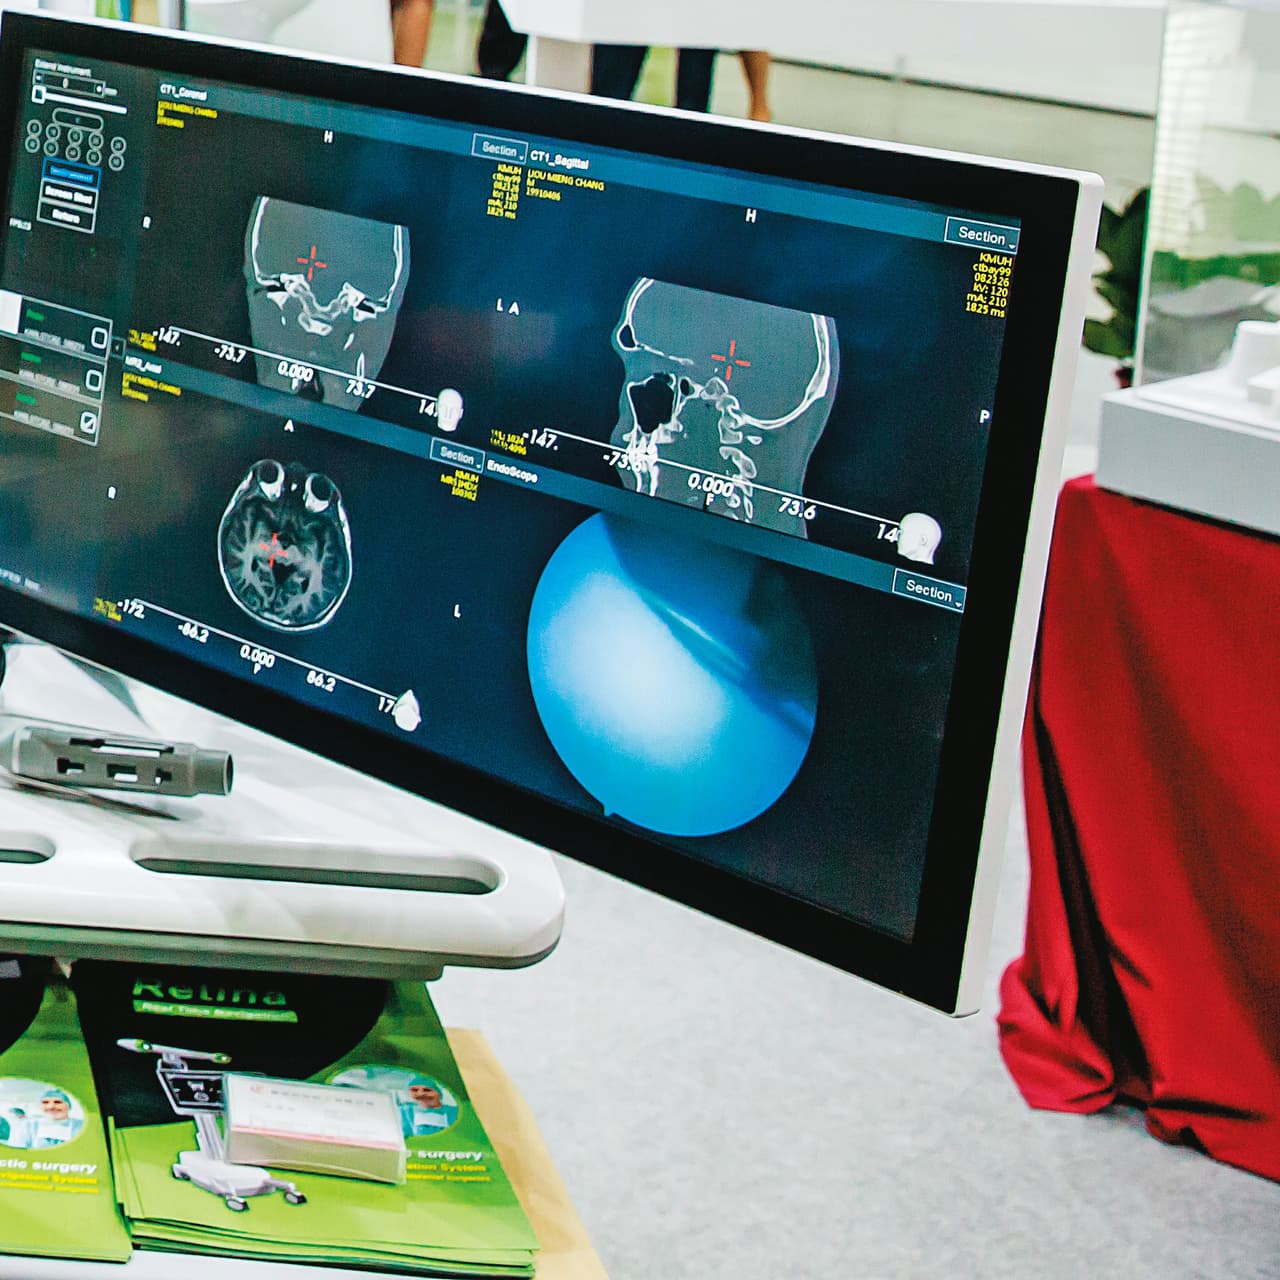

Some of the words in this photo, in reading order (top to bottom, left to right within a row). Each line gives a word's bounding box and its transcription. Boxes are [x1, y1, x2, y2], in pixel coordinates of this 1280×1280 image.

[323, 130, 334, 144] H
[482, 141, 517, 157] Section
[530, 150, 589, 170] CT1_Sagittal
[575, 178, 605, 191] CHANG
[745, 208, 757, 223] H
[958, 226, 1006, 245] Section
[980, 252, 1013, 267] KMUH
[972, 263, 1012, 278] ctbay99
[974, 272, 1010, 288] 082326
[991, 286, 1008, 298] 120
[496, 297, 504, 312] L
[508, 301, 520, 316] A
[988, 296, 1007, 308] 210
[965, 302, 989, 315] 1825
[990, 308, 1006, 319] ms
[278, 360, 314, 383] 0.000
[344, 379, 377, 400] 73.7
[418, 399, 438, 418] 14
[980, 410, 990, 424] P
[283, 419, 295, 433] A
[440, 446, 474, 465] Section
[487, 459, 538, 483] EndoScope
[687, 473, 735, 498] 0.000
[705, 493, 715, 506] F
[778, 496, 817, 521] 73.6
[876, 523, 900, 543] 14
[906, 579, 953, 604] Section
[240, 644, 276, 668] 0.000
[306, 670, 337, 693] 86.2
[378, 696, 396, 714] 17
[417, 1148, 482, 1162] surgery
[32, 1161, 97, 1175] surgery
